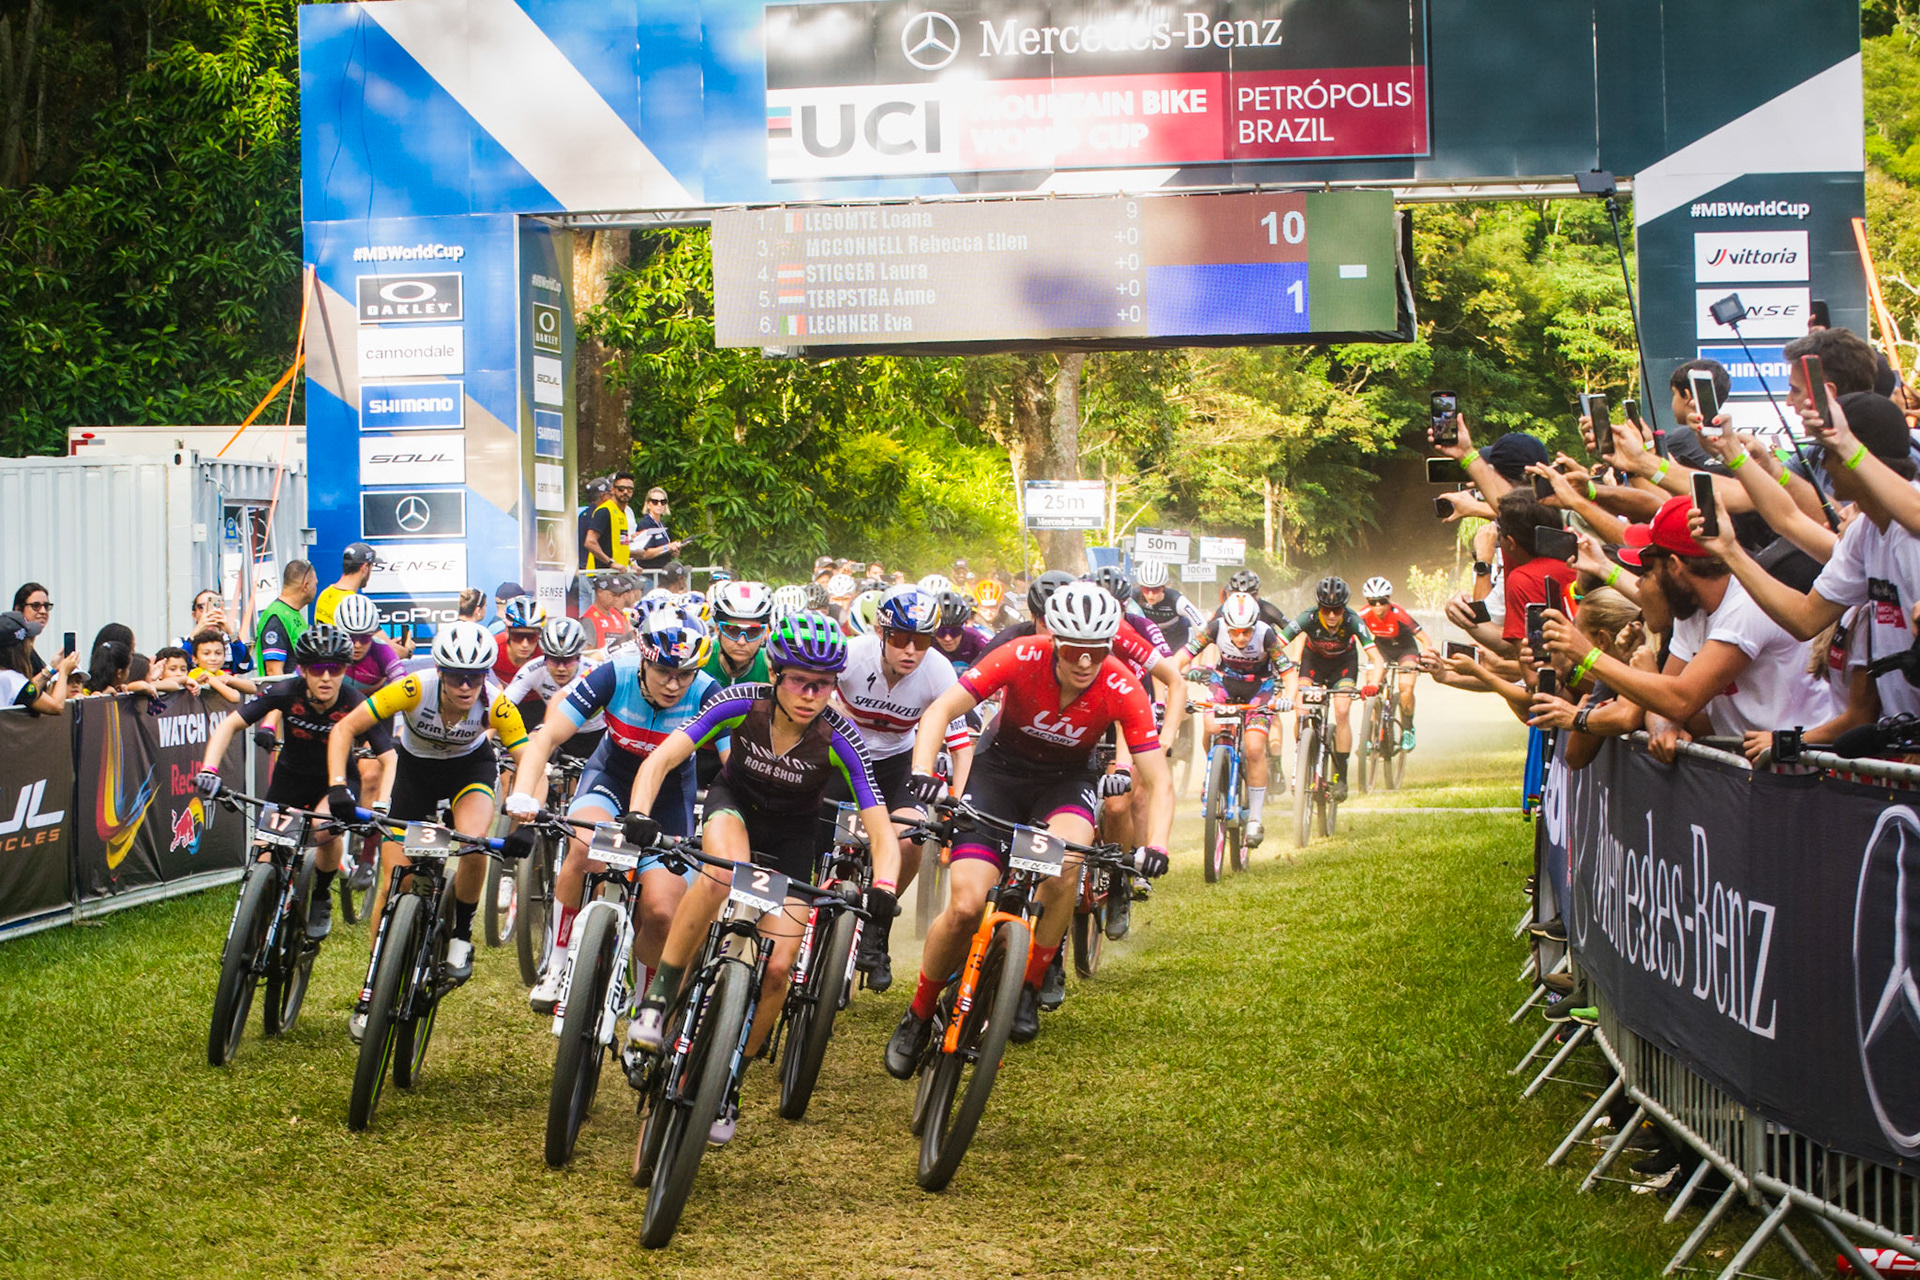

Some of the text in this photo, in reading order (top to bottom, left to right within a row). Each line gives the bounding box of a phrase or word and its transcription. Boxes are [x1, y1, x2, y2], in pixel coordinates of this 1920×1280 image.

[979, 12, 1284, 57] Mercedes-Benz
[1142, 89, 1208, 115] BIKE
[1238, 78, 1412, 111] PETRÓPOLIS
[801, 100, 941, 158] UCI
[970, 123, 1149, 152] WORD CUP
[1239, 118, 1335, 144] BRAZIL
[882, 210, 933, 229] Loana
[1126, 202, 1138, 219] 9
[1690, 200, 1811, 220] #MBWorldCup
[1261, 210, 1306, 245] 10
[353, 243, 465, 262] #MBWorldCup
[806, 237, 904, 258] MCCONNELL
[907, 234, 983, 254] Rebecca
[987, 232, 1028, 251] Ellen
[1114, 227, 1139, 246] +0
[880, 263, 929, 281] Laura
[1115, 253, 1140, 271] +0
[1728, 247, 1798, 265] vittoria
[807, 288, 890, 309] TERPSTRA
[894, 286, 936, 305] Anne
[1116, 279, 1141, 298] +0
[1286, 280, 1304, 314] 1
[366, 302, 453, 316] OAKLEY
[808, 315, 879, 334] LECHNER
[884, 313, 913, 332] Eva
[1116, 305, 1142, 323] +0
[365, 344, 455, 360] cannondale
[368, 397, 454, 414] SHIMANO
[368, 453, 455, 465] SOUL
[1043, 494, 1085, 510] 25m
[1147, 537, 1178, 551] 50m
[371, 560, 457, 572] SENSE
[539, 586, 564, 598] SENSE
[1015, 645, 1043, 661] Liv
[1106, 672, 1134, 695] Liv
[852, 695, 921, 718] SPECIALIZED
[1305, 690, 1323, 702] 28
[157, 712, 207, 748] WATCH
[1033, 710, 1088, 739] Liv
[607, 721, 660, 752] TRE
[1027, 728, 1074, 745] FACTORY
[270, 812, 294, 832] 17
[420, 828, 437, 844] 3
[612, 832, 624, 849] 1
[1030, 833, 1049, 854] 5
[751, 870, 770, 893] 2
[1592, 781, 1777, 1041] Mercedes-Benz
